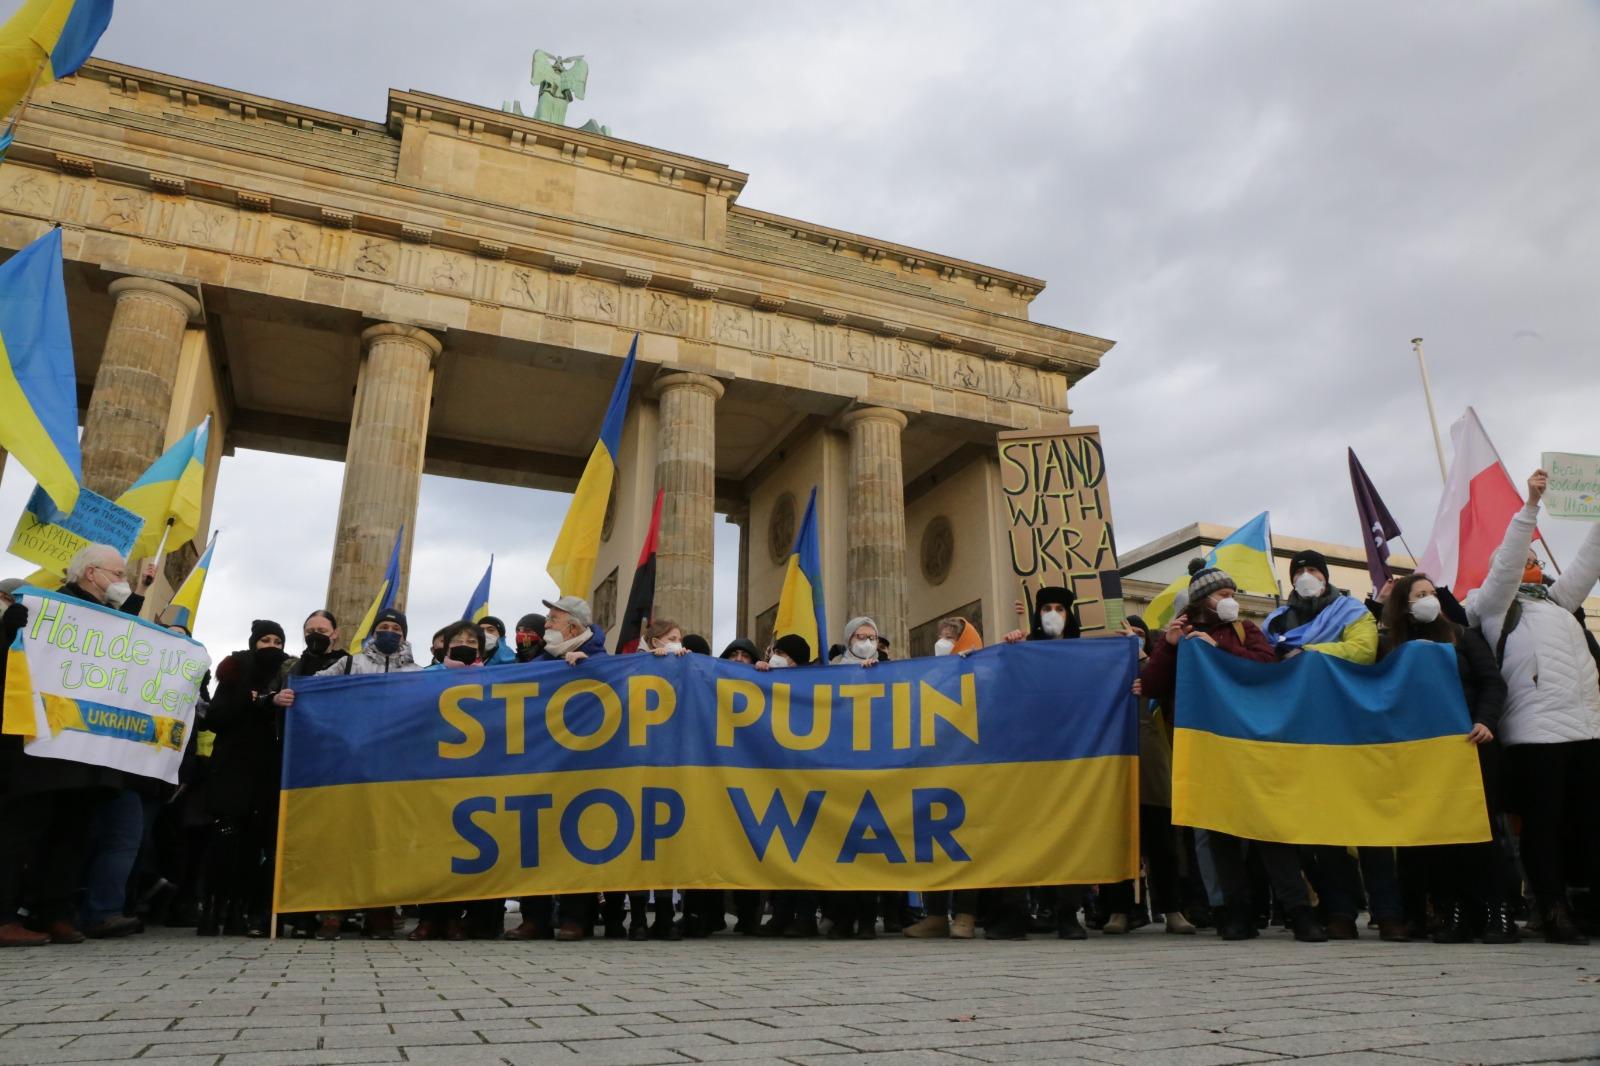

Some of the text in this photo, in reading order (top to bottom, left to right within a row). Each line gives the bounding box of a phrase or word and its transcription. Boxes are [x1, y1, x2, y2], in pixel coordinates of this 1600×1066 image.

[1002, 436, 1106, 496] STAND
[1008, 521, 1119, 577] UKRA
[30, 598, 154, 665] Hände
[87, 707, 149, 735] UKRAINE
[437, 672, 980, 760] STOP PUTIN
[450, 786, 972, 875] STOP WAR
